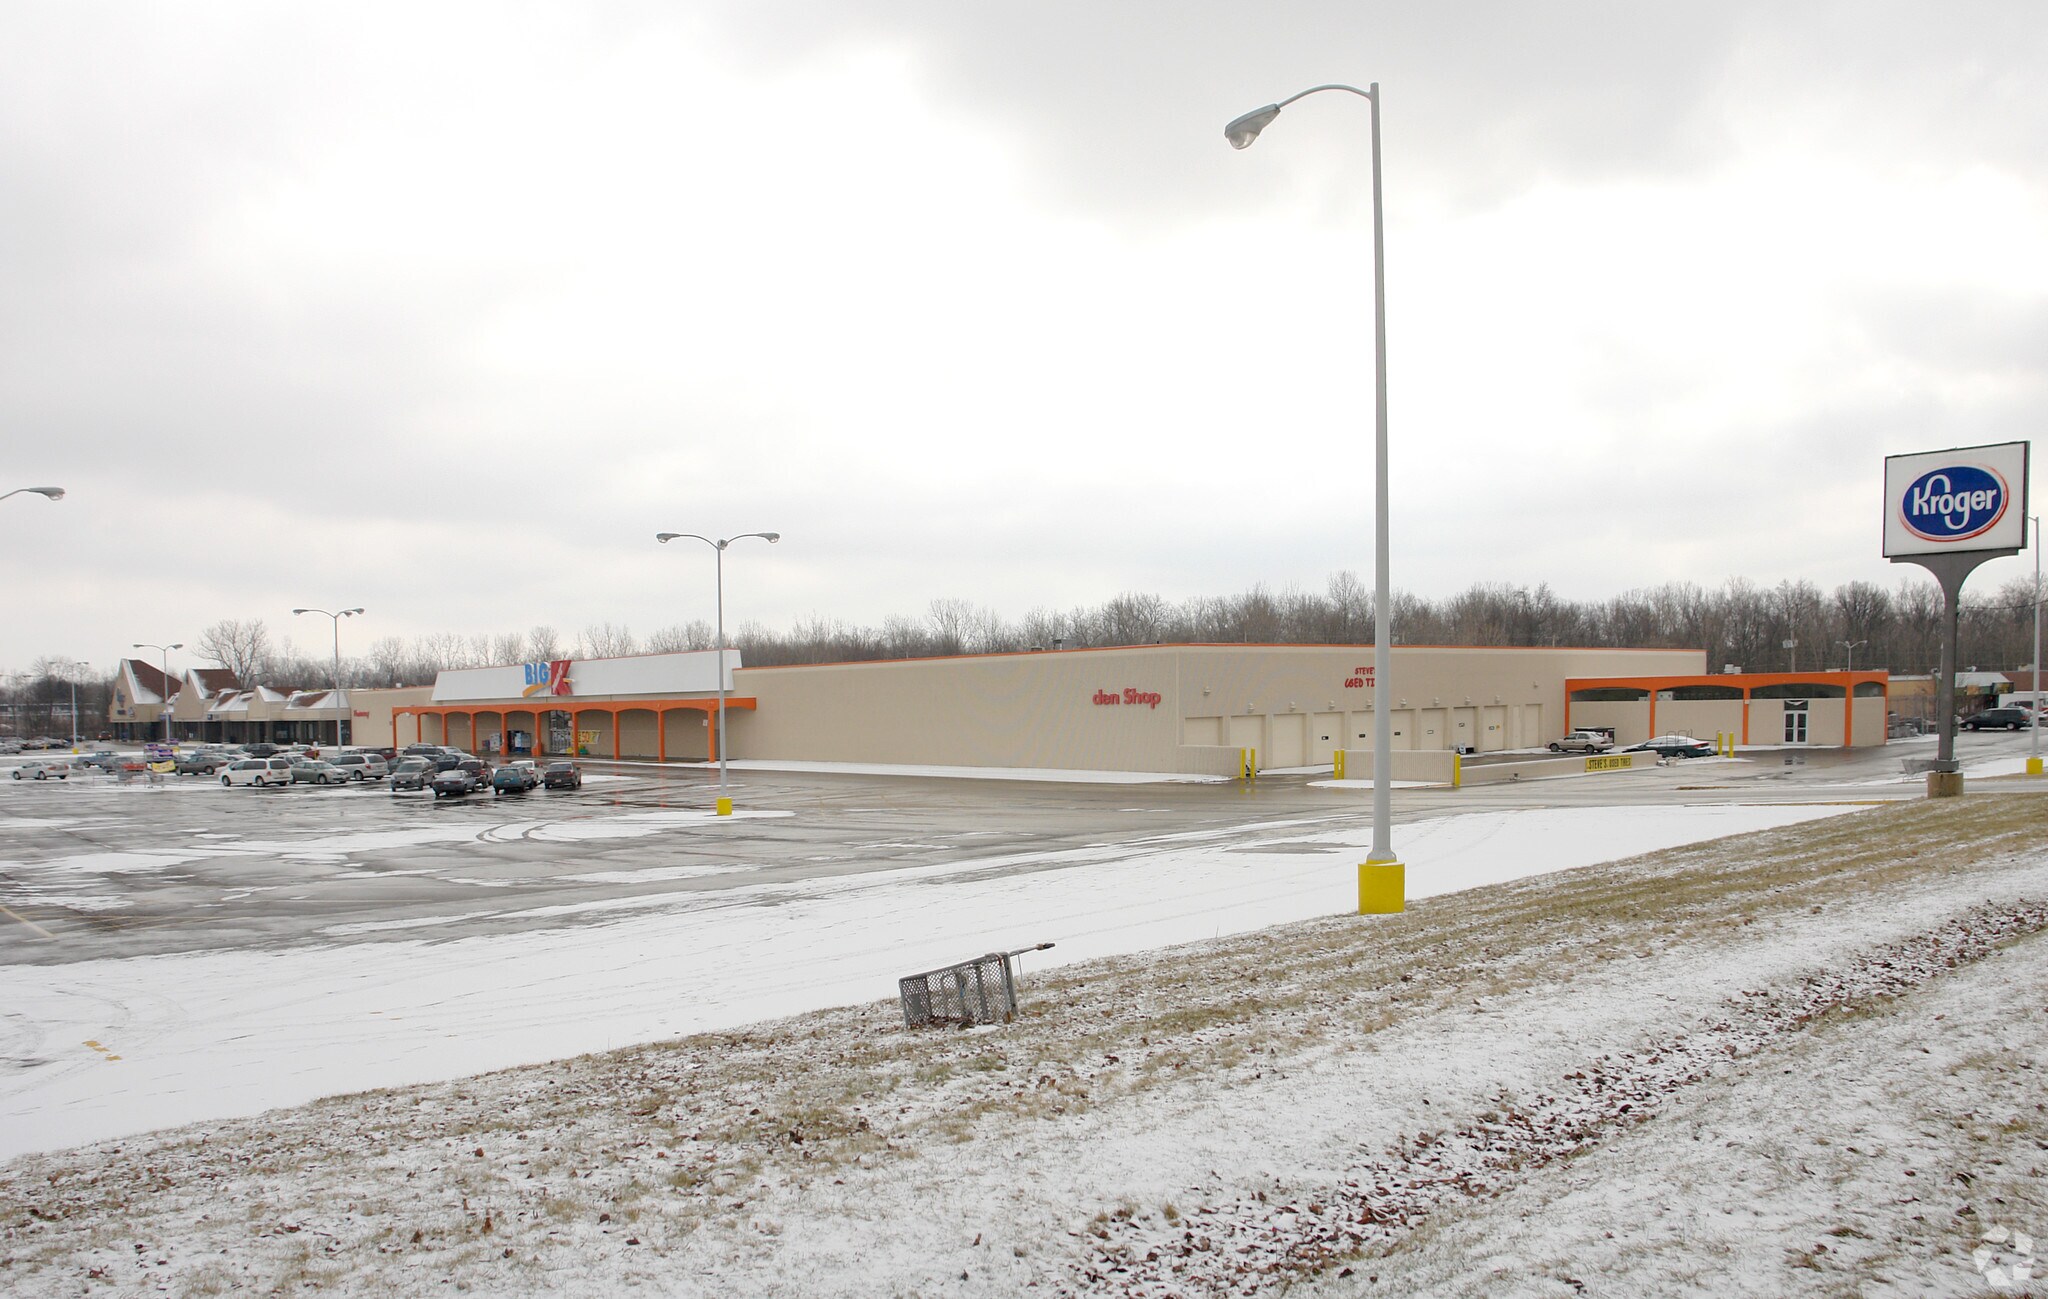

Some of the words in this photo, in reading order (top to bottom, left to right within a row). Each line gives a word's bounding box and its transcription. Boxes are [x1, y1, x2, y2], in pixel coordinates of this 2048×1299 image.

[1912, 474, 1998, 530] Kroger
[524, 661, 550, 685] BIG
[550, 659, 573, 695] K
[1354, 666, 1375, 675] STEVE
[1092, 689, 1120, 705] den
[1123, 688, 1162, 709] Shop
